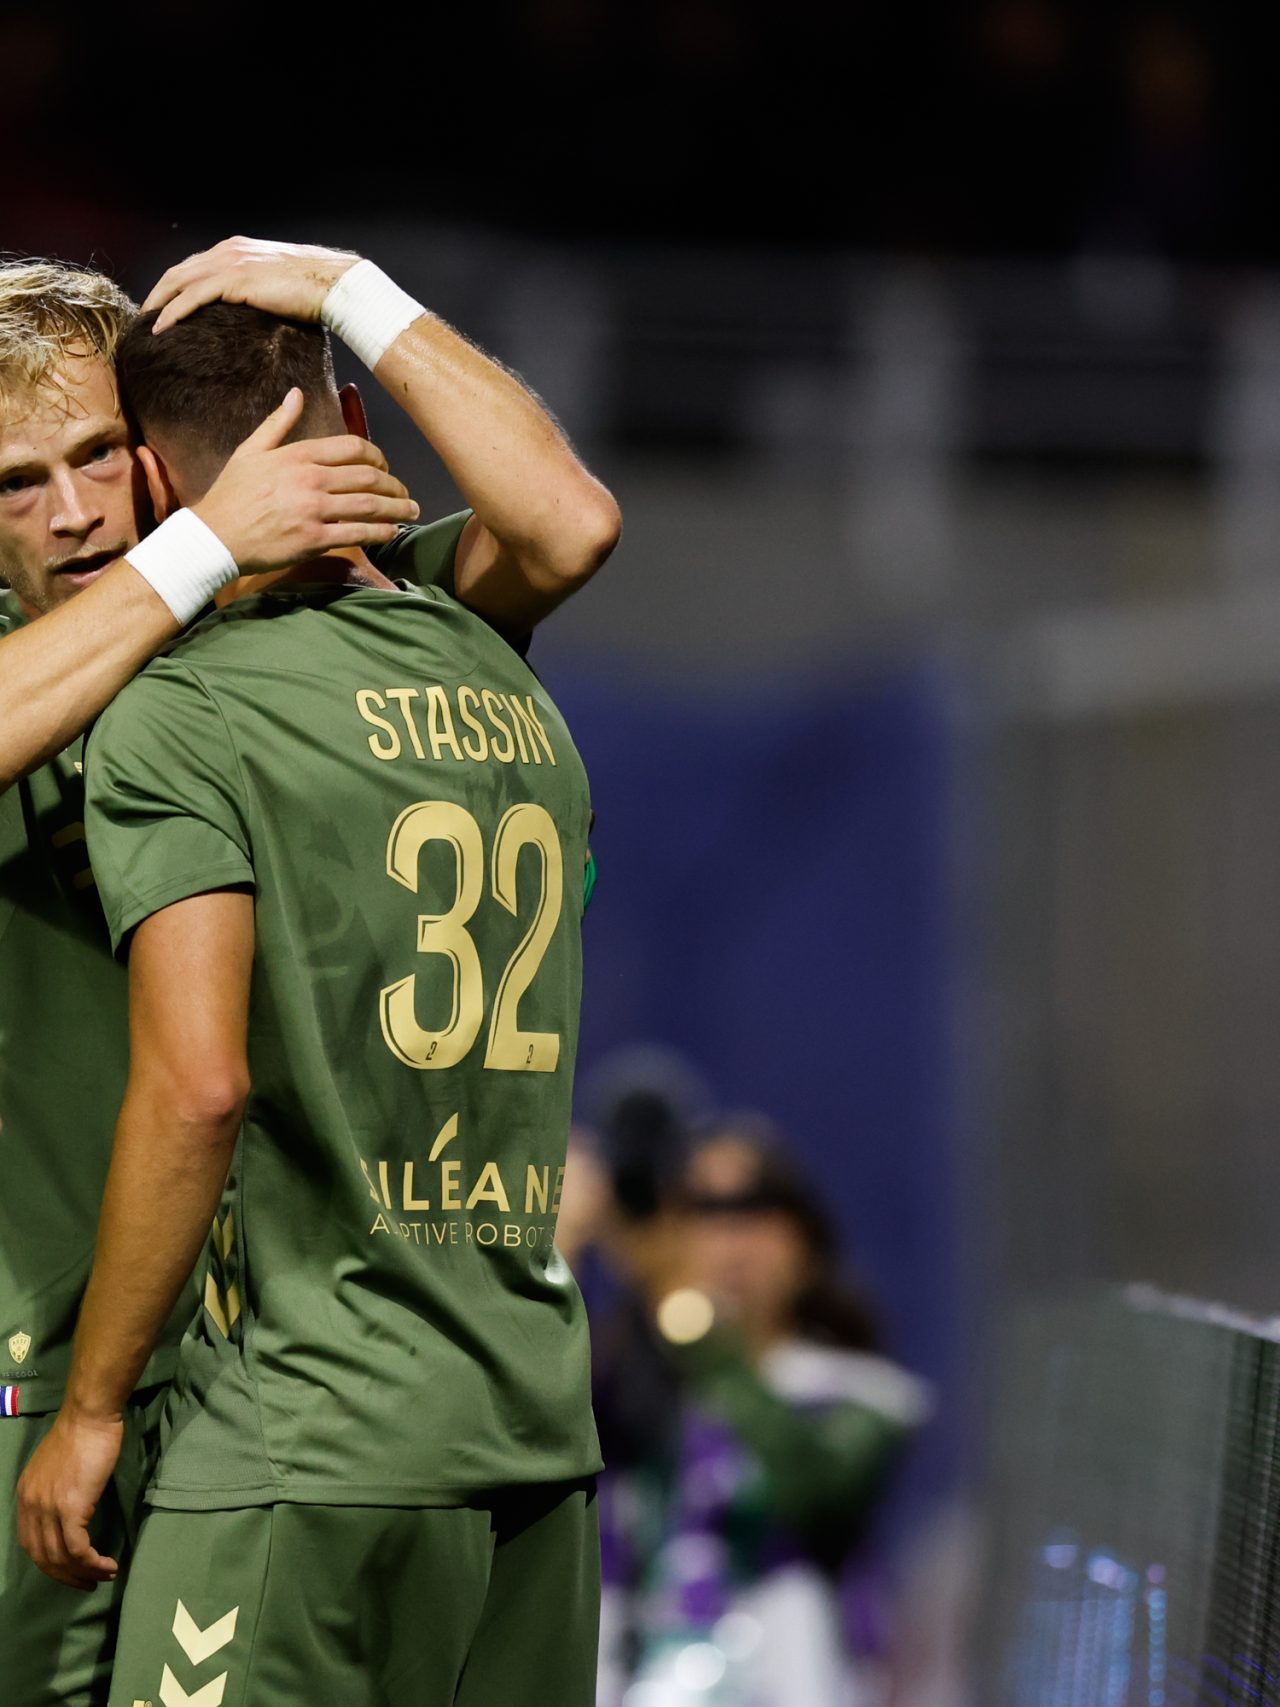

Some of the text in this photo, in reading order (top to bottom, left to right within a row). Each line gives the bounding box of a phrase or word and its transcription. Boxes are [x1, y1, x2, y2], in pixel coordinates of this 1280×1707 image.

[355, 685, 557, 766] STASSIN
[379, 800, 564, 1072] 32
[360, 1112, 565, 1215] ILÉANE
